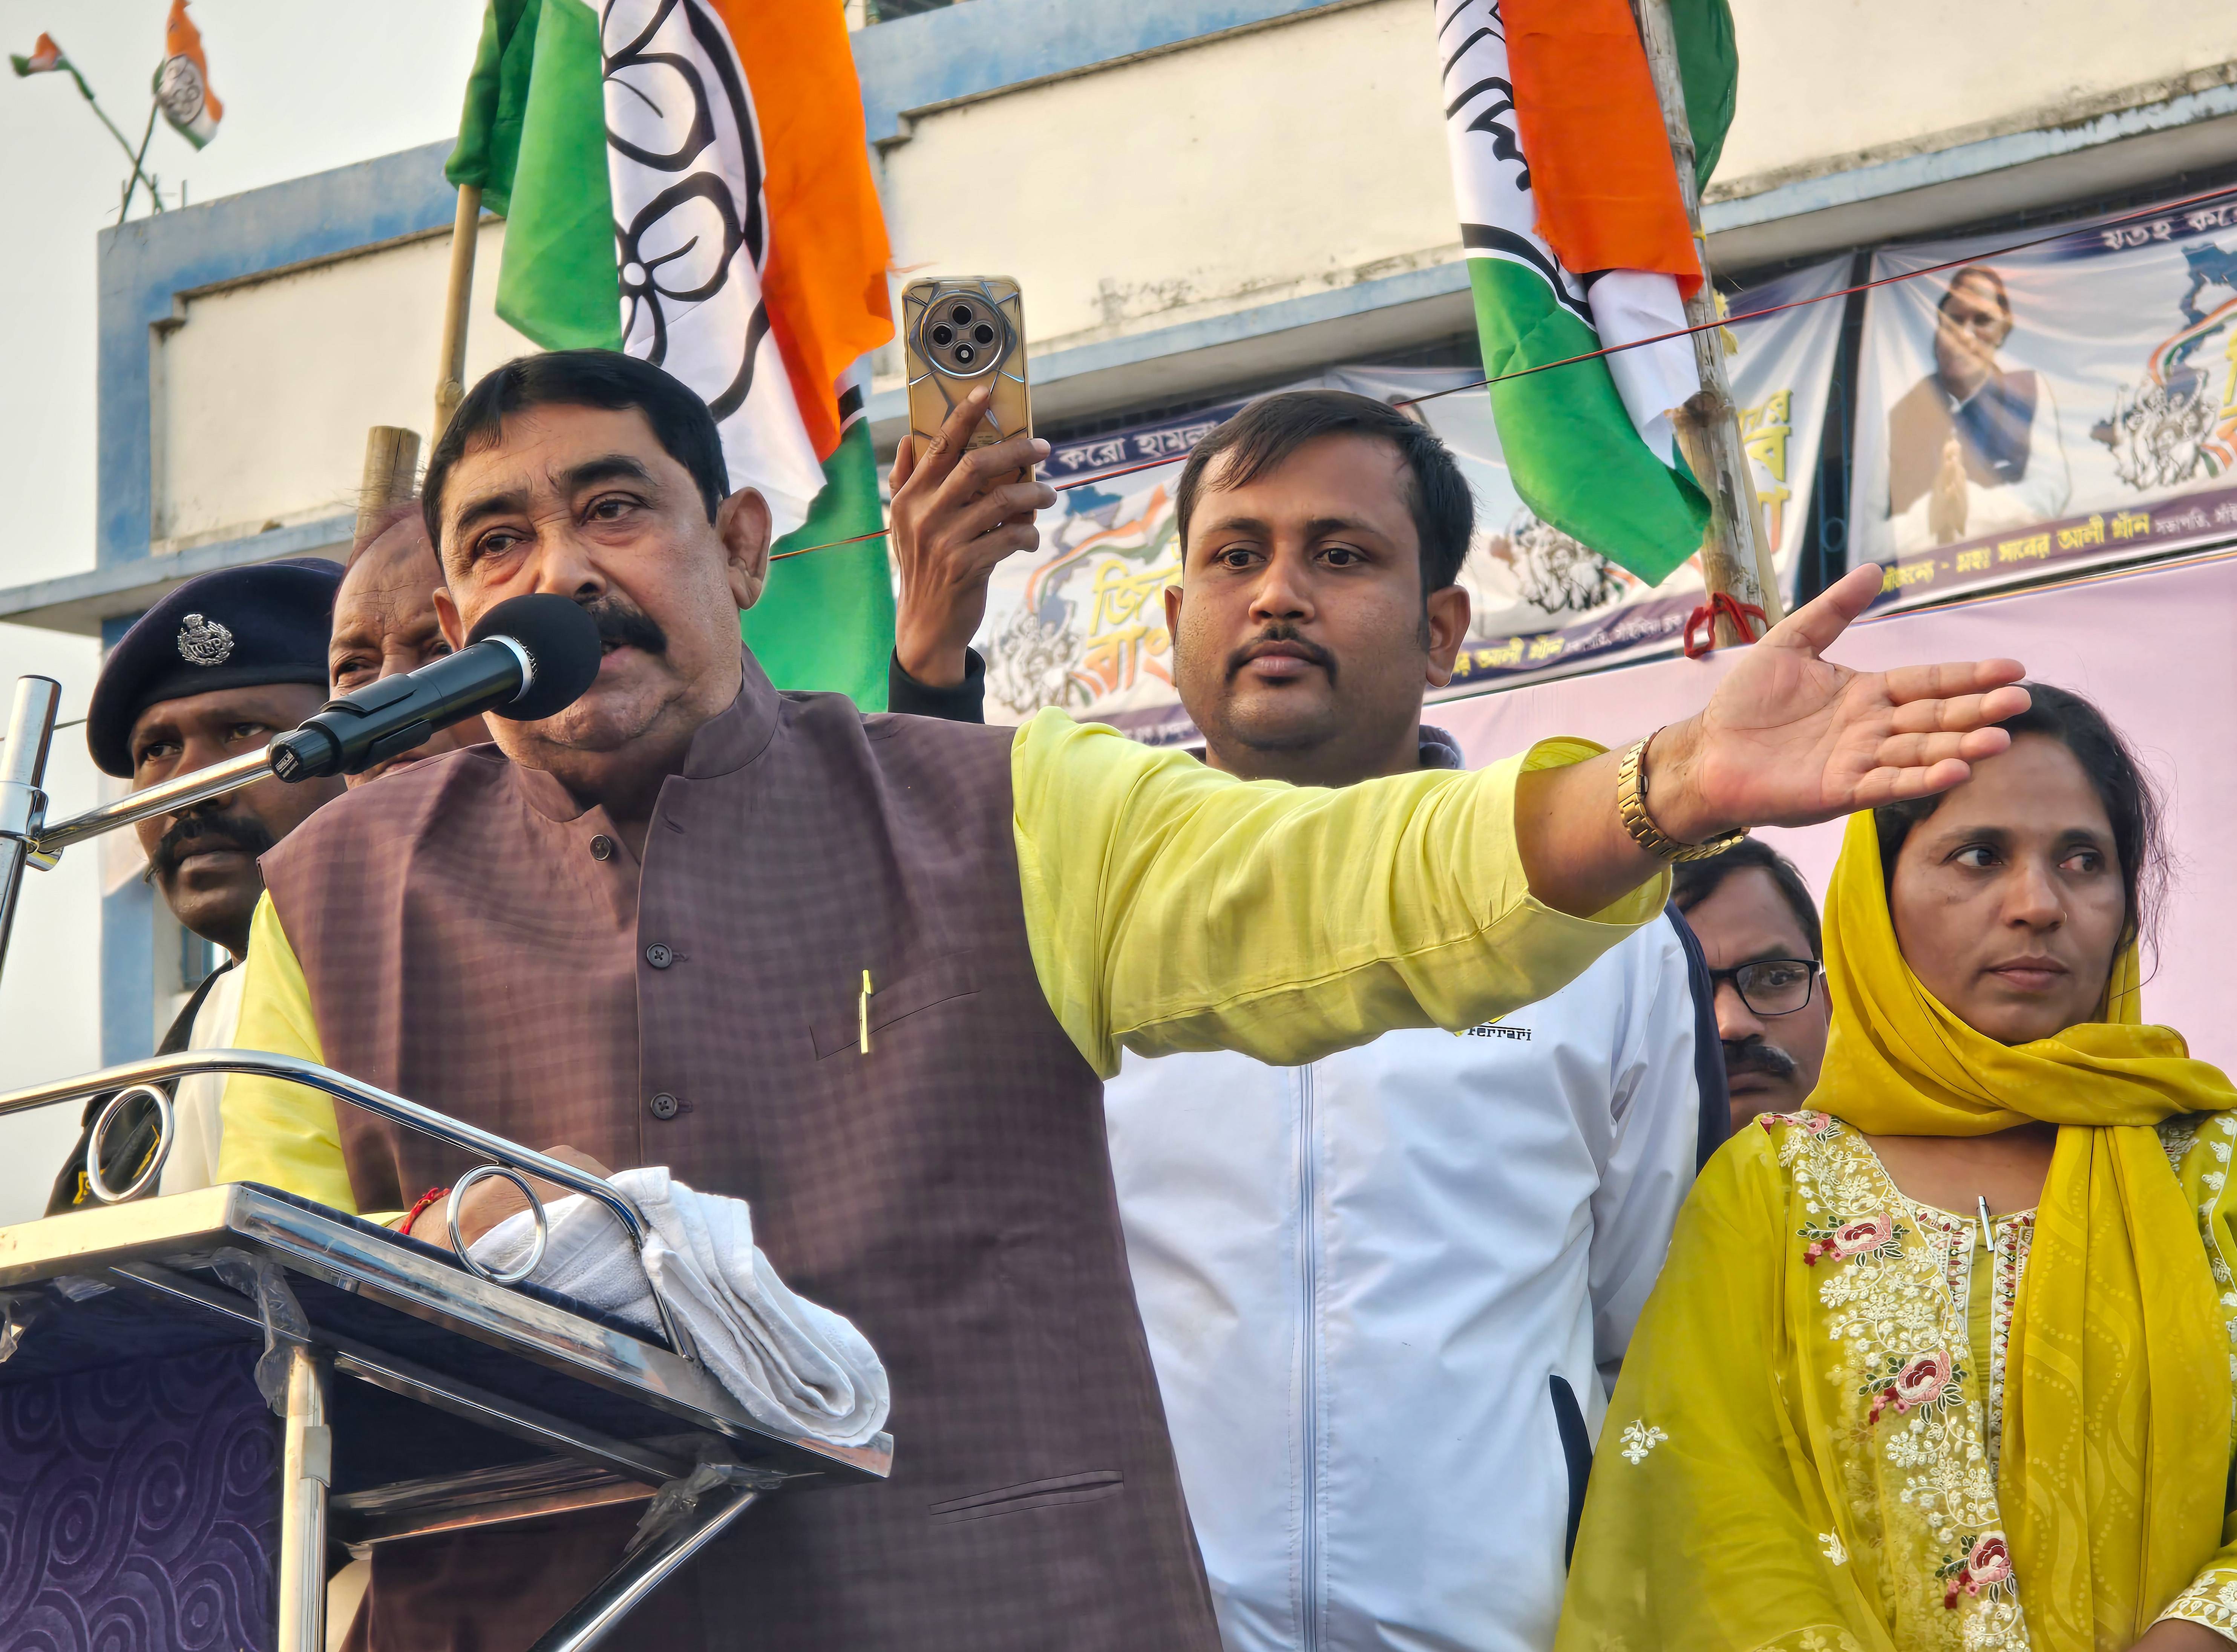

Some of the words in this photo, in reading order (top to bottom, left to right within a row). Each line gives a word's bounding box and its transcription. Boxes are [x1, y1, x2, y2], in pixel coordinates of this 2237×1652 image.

[1056, 438, 1126, 470] করো
[1133, 420, 1218, 457] হামল
[2058, 513, 2105, 550] আলী
